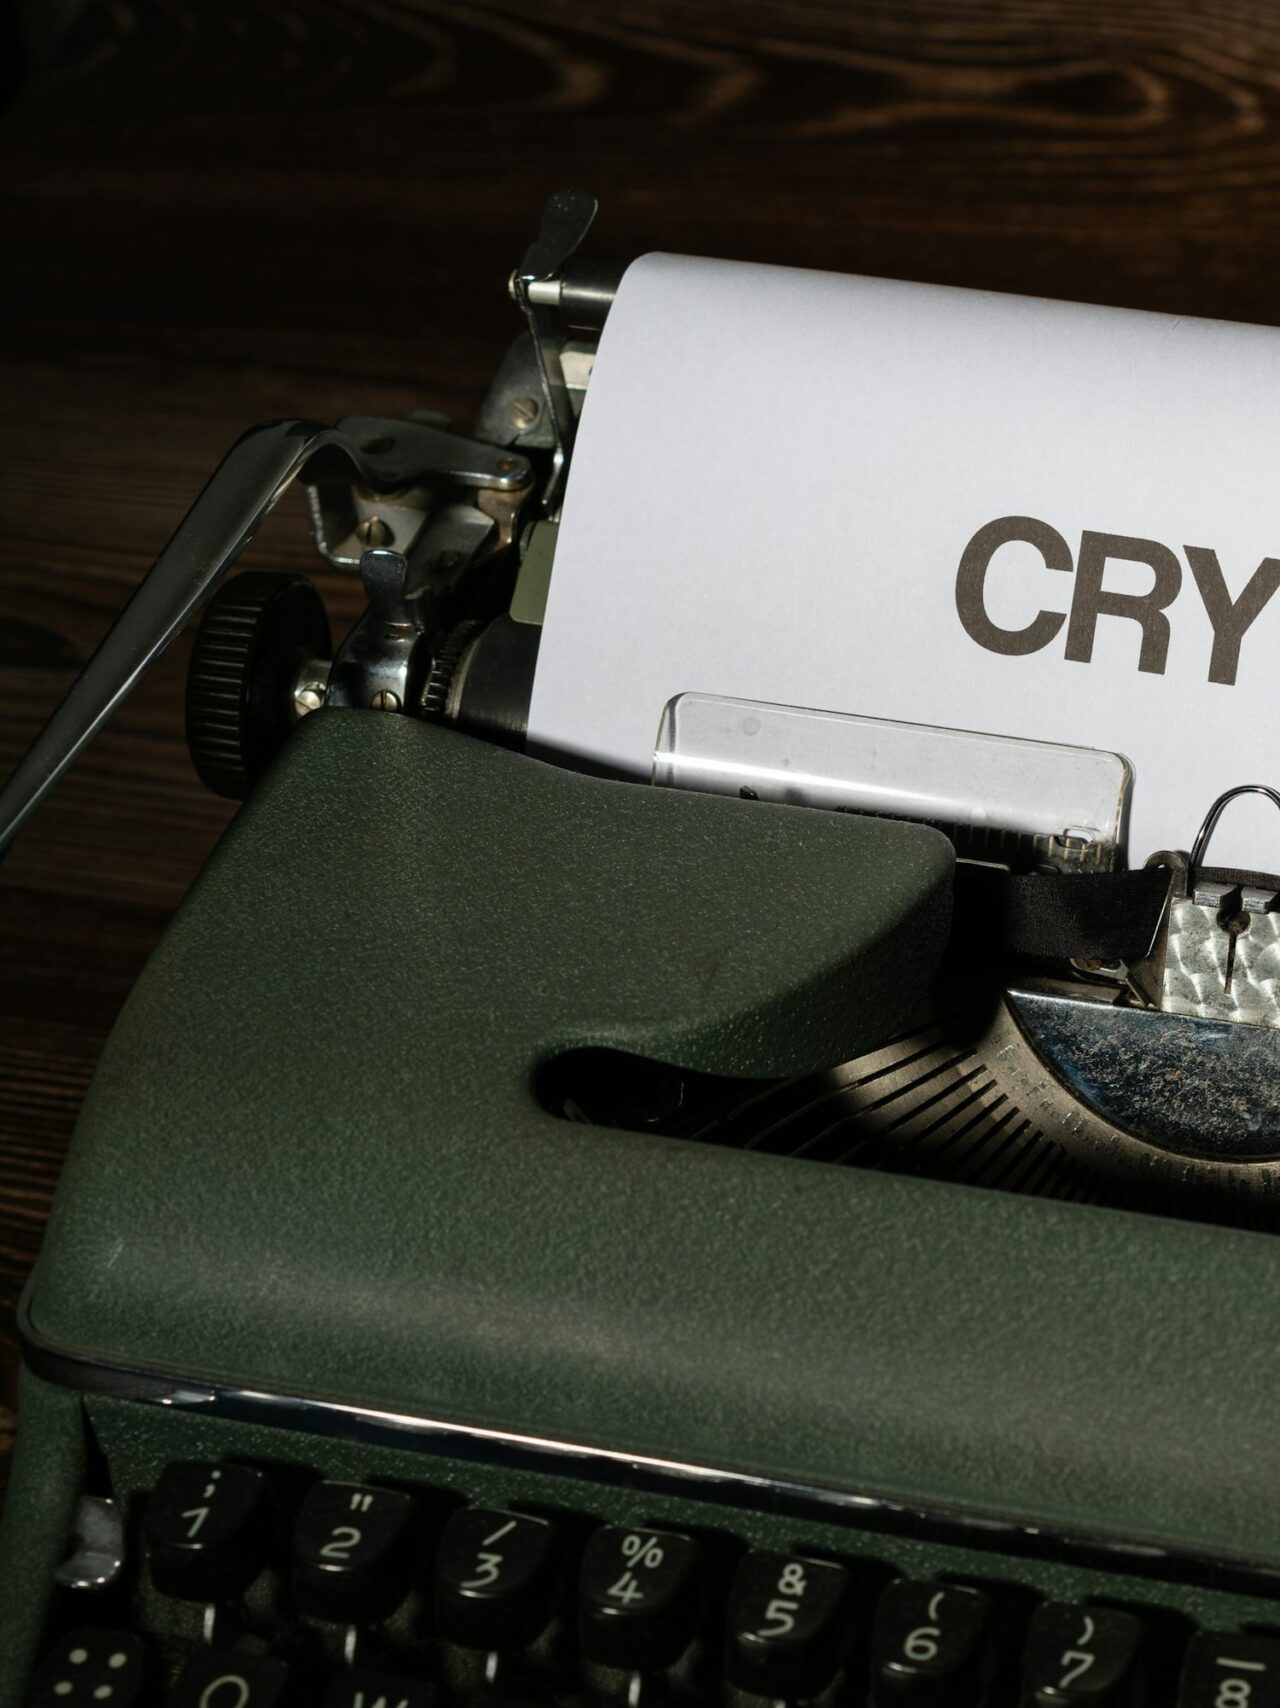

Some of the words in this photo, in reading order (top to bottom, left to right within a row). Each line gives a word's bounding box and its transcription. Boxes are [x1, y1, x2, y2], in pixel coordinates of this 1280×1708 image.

[181, 1506, 210, 1538] 1
[319, 1526, 362, 1559] 2
[621, 1534, 665, 1569] %
[461, 1552, 504, 1588] 3
[777, 1562, 808, 1597] &
[606, 1571, 644, 1605] 4
[757, 1599, 800, 1637] 5
[928, 1591, 945, 1621] (
[903, 1626, 941, 1662] 6
[1075, 1615, 1095, 1646] )
[1059, 1650, 1096, 1688] 7
[1214, 1678, 1253, 1708] 8
